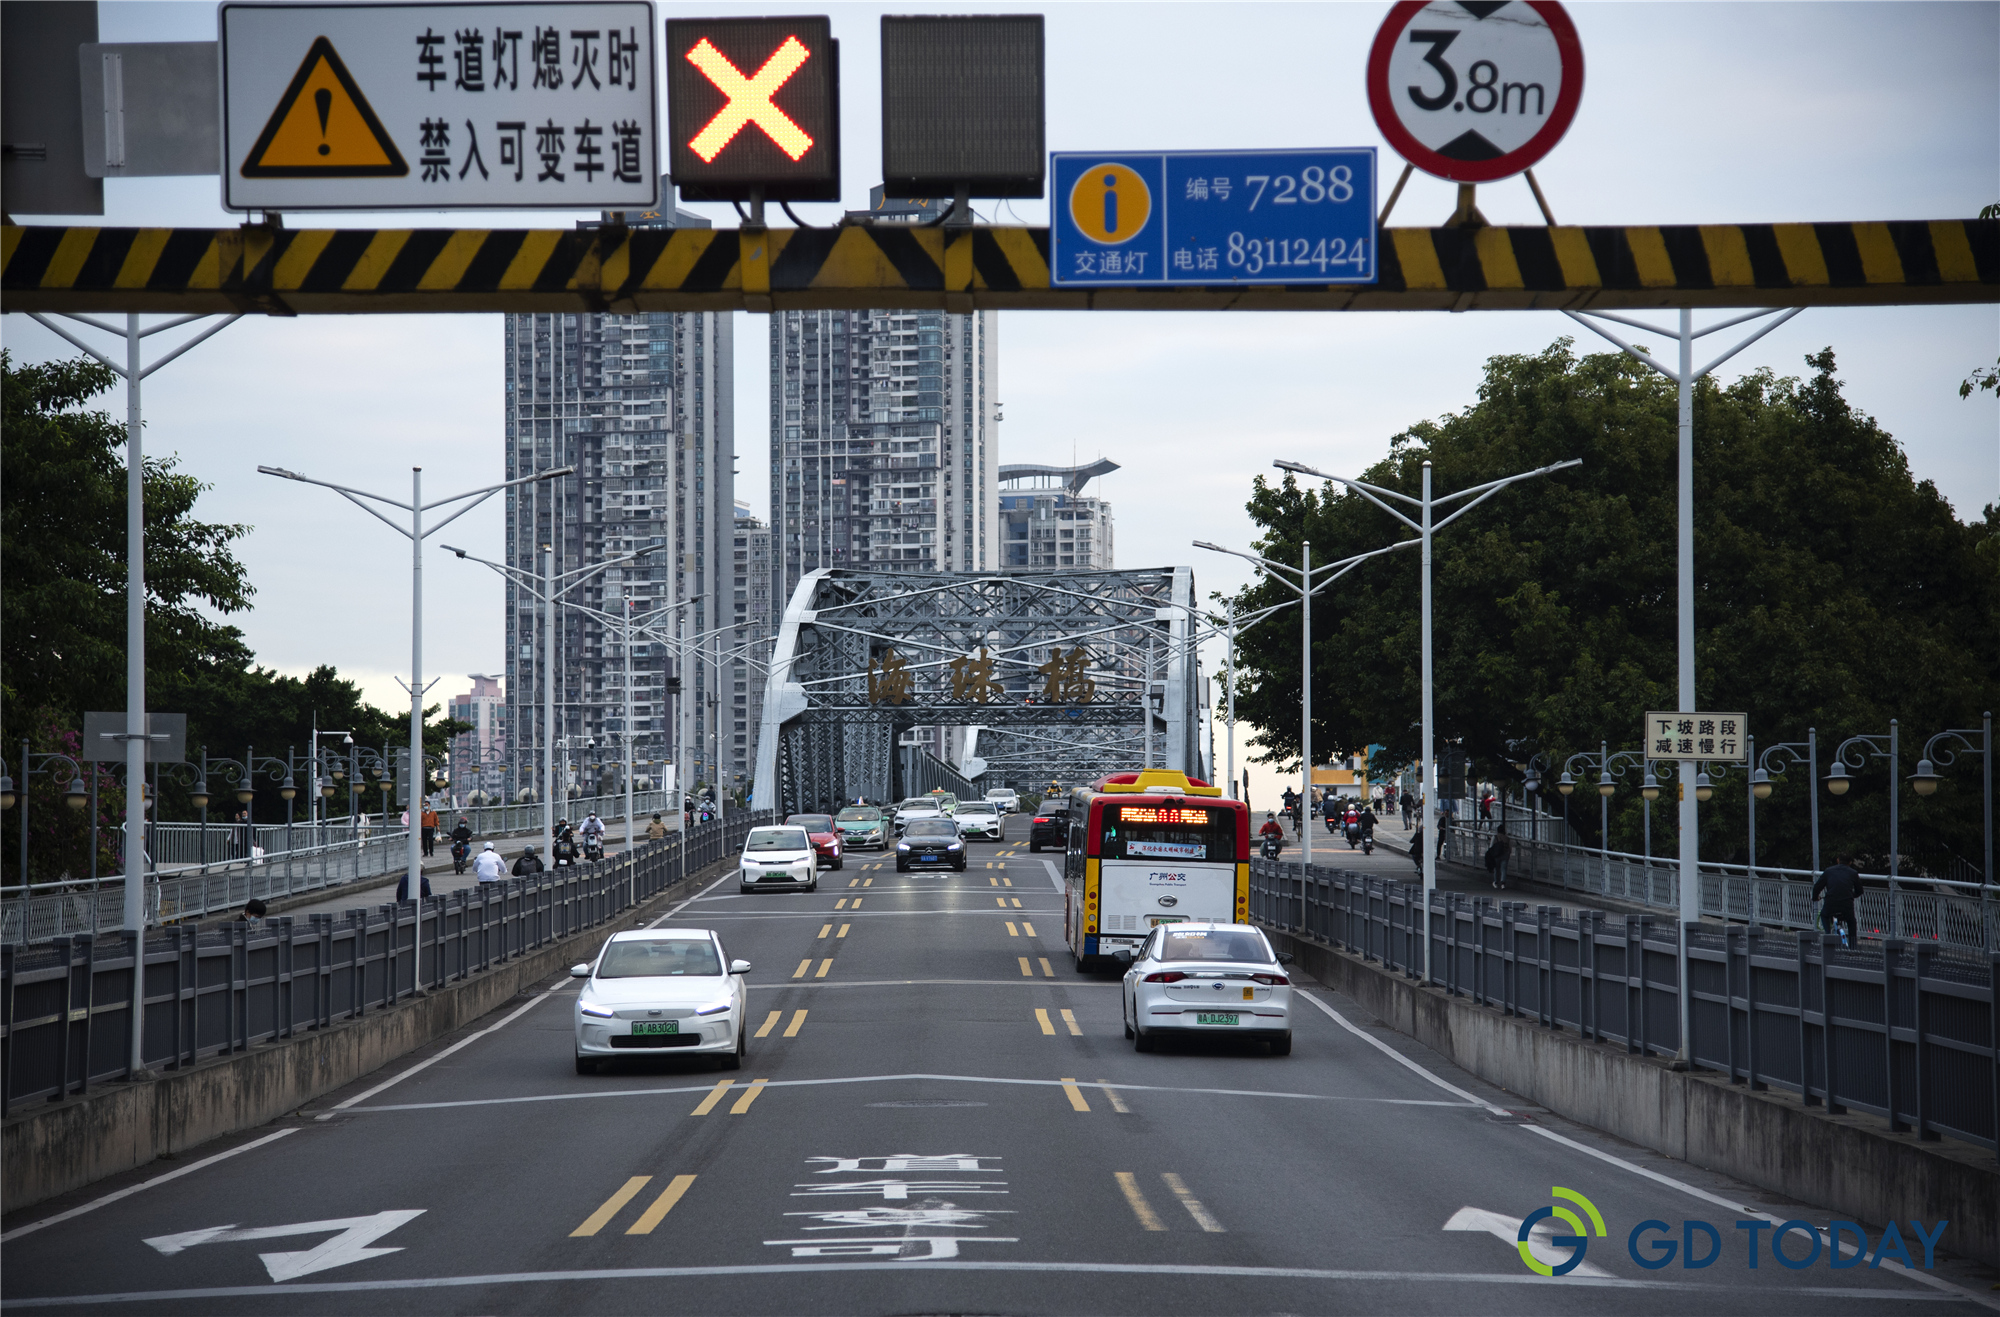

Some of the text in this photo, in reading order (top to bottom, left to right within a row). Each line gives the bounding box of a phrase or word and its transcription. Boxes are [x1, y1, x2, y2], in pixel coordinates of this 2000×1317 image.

[416, 25, 639, 92] 车道灯熄灭时
[1407, 28, 1545, 115] 3.8m
[419, 117, 643, 183] 禁入可变车道
[1185, 165, 1354, 212] 编号 7288
[1074, 250, 1149, 275] 交通灯
[1173, 231, 1367, 274] 电话 83112424
[1656, 719, 1737, 735] 下坡路段
[1656, 738, 1737, 754] 减速慢行
[1149, 872, 1187, 881] 广州公交
